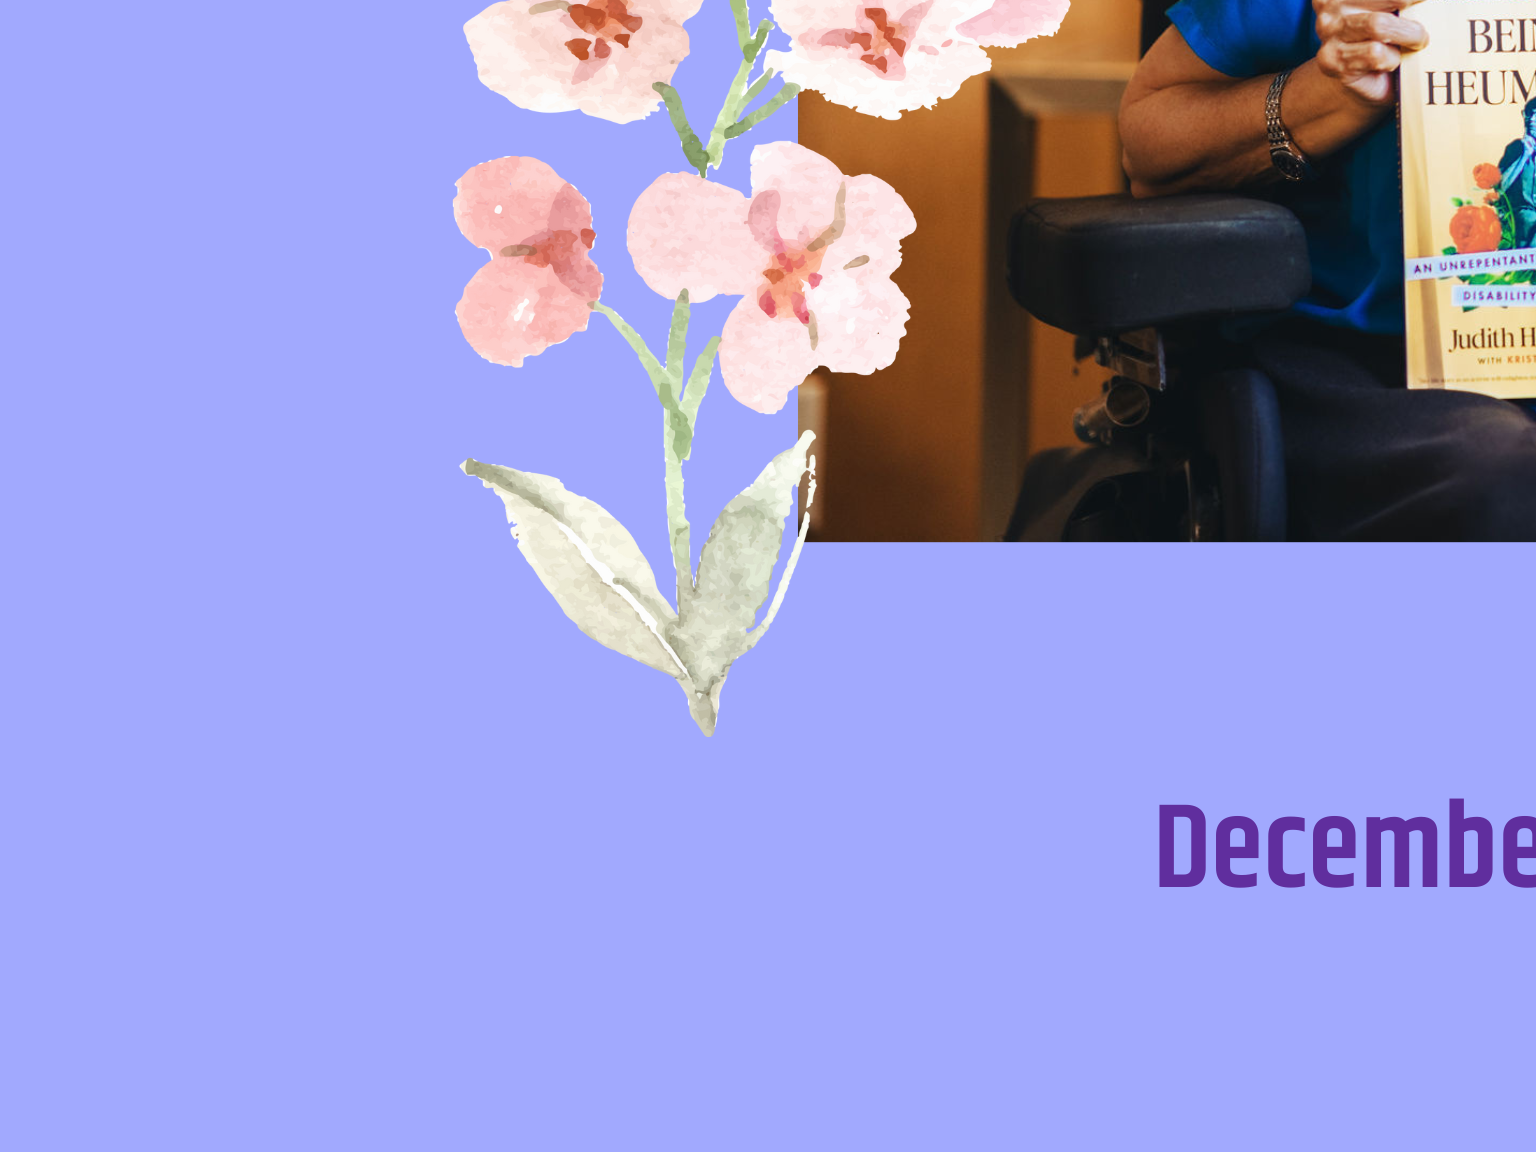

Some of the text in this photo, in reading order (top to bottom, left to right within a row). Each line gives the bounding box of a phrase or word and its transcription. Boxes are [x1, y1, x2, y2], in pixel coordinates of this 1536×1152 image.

[1414, 263, 1432, 274] AN
[1439, 254, 1536, 272] UNREPENTANT
[1463, 291, 1536, 301] DISABILITY
[1448, 327, 1516, 353] Judith
